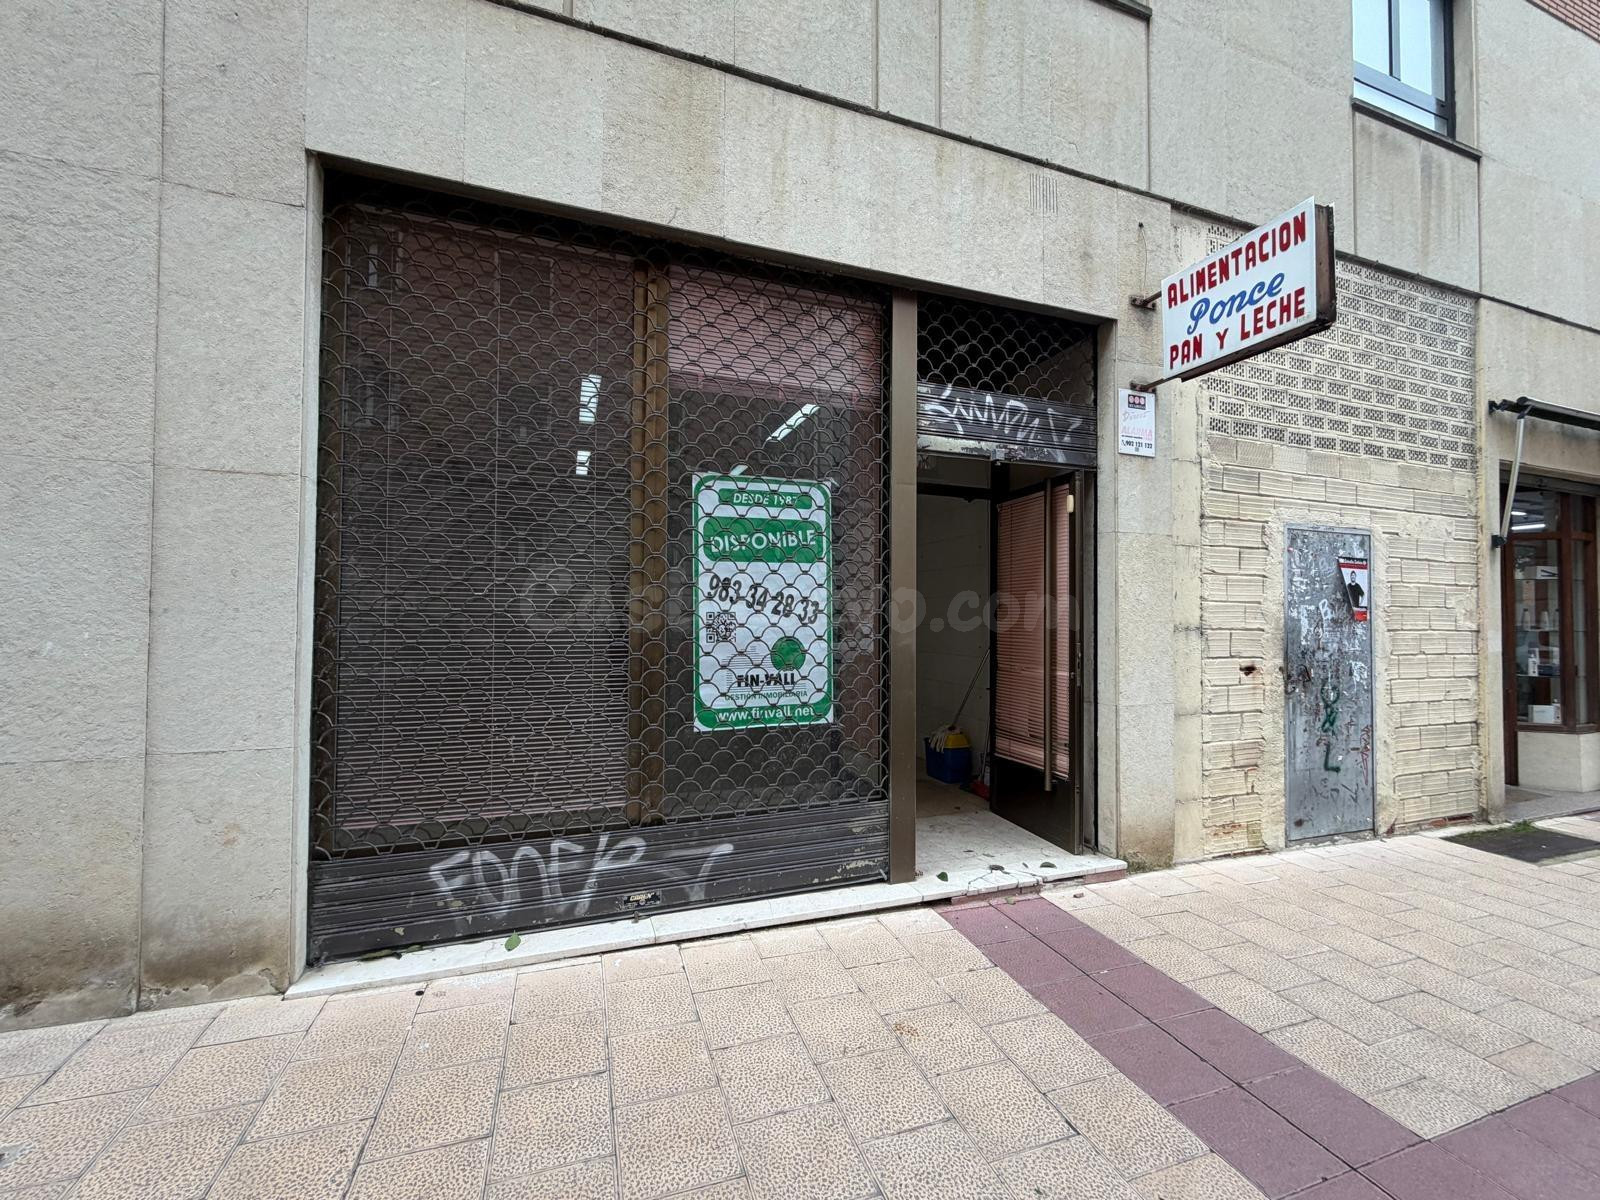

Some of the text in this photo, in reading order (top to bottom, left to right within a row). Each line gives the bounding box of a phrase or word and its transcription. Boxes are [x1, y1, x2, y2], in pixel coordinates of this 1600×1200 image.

[1167, 211, 1306, 309] ALIMENTACION
[1169, 287, 1305, 370] PAN Y LECHE
[1187, 272, 1285, 336] Ponce
[733, 493, 769, 505] DESDE
[710, 529, 816, 553] DISPONIBLE
[709, 574, 820, 625] 983 34 28 33
[737, 672, 796, 687] FIN-VALL
